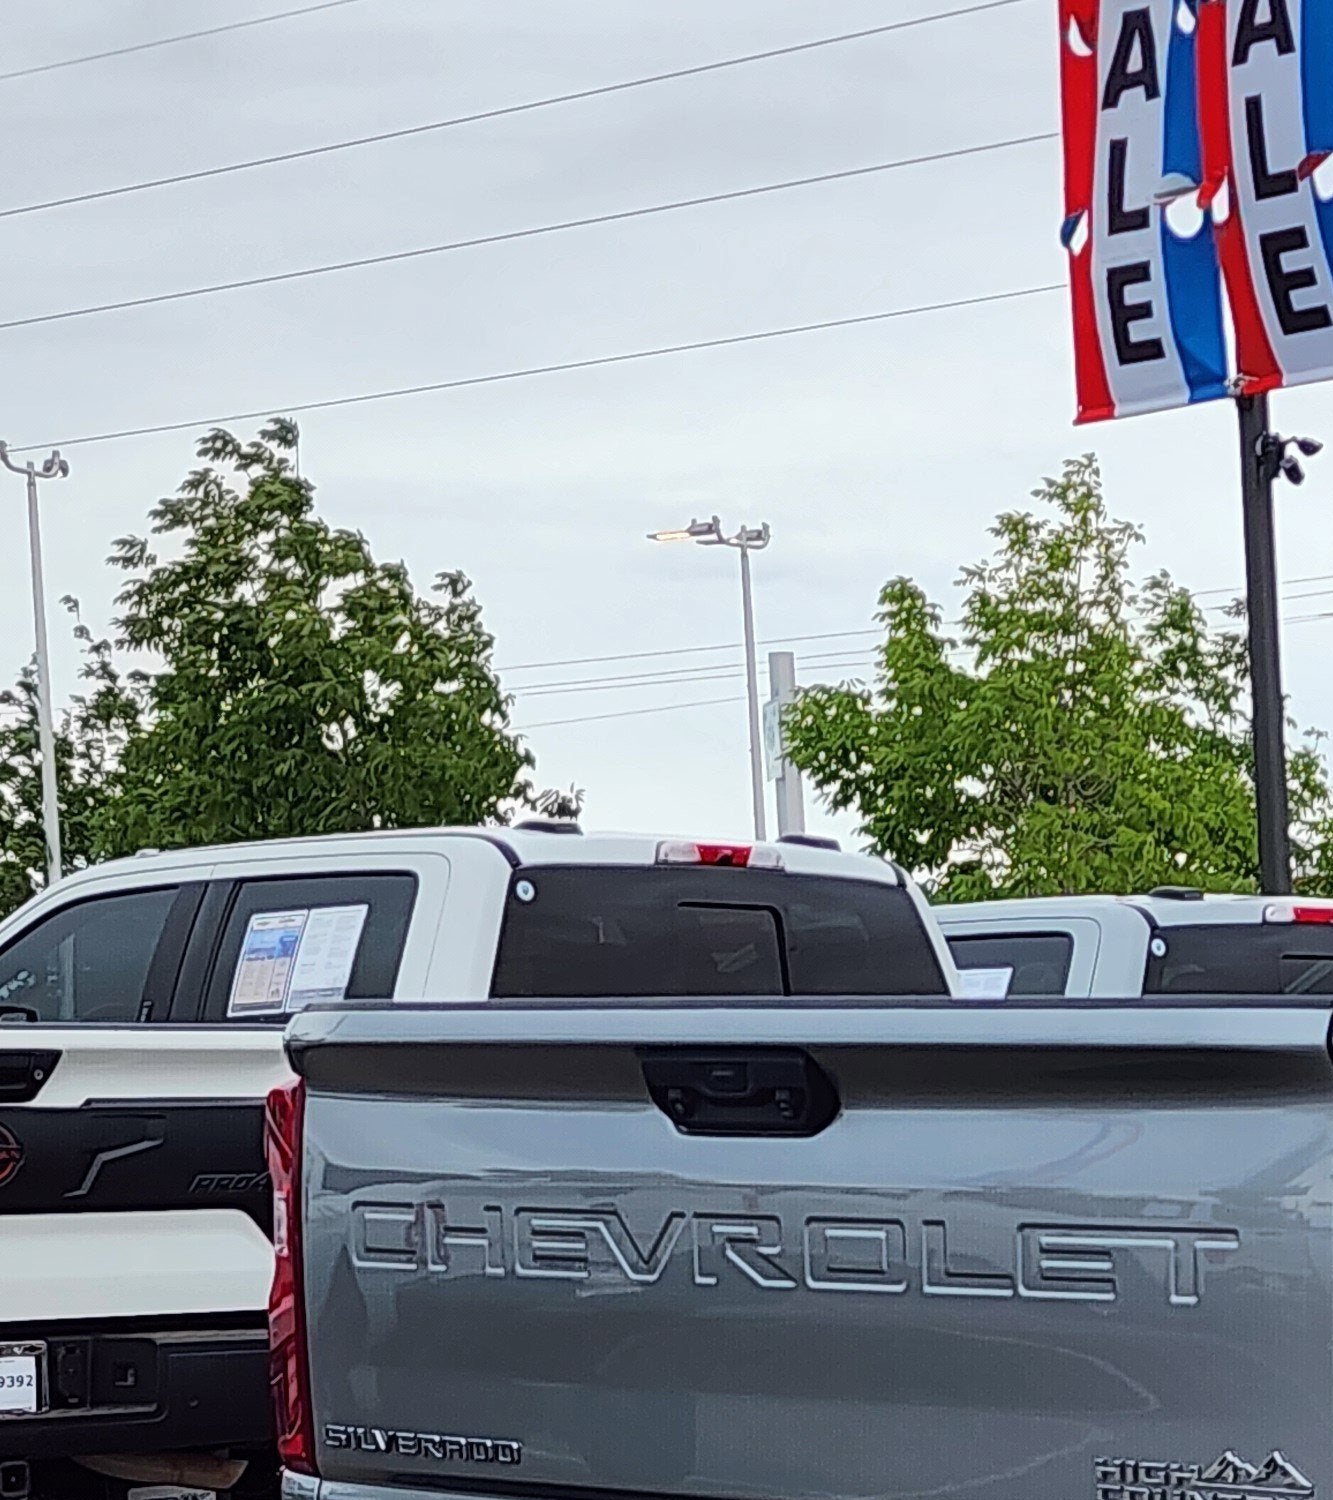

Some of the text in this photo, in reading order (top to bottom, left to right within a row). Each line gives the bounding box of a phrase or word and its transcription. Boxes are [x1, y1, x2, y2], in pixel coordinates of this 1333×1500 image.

[348, 1201, 1241, 1305] CHEVROLET
[325, 1423, 522, 1465] SILVERADO
[1095, 1456, 1201, 1487] HIGH
